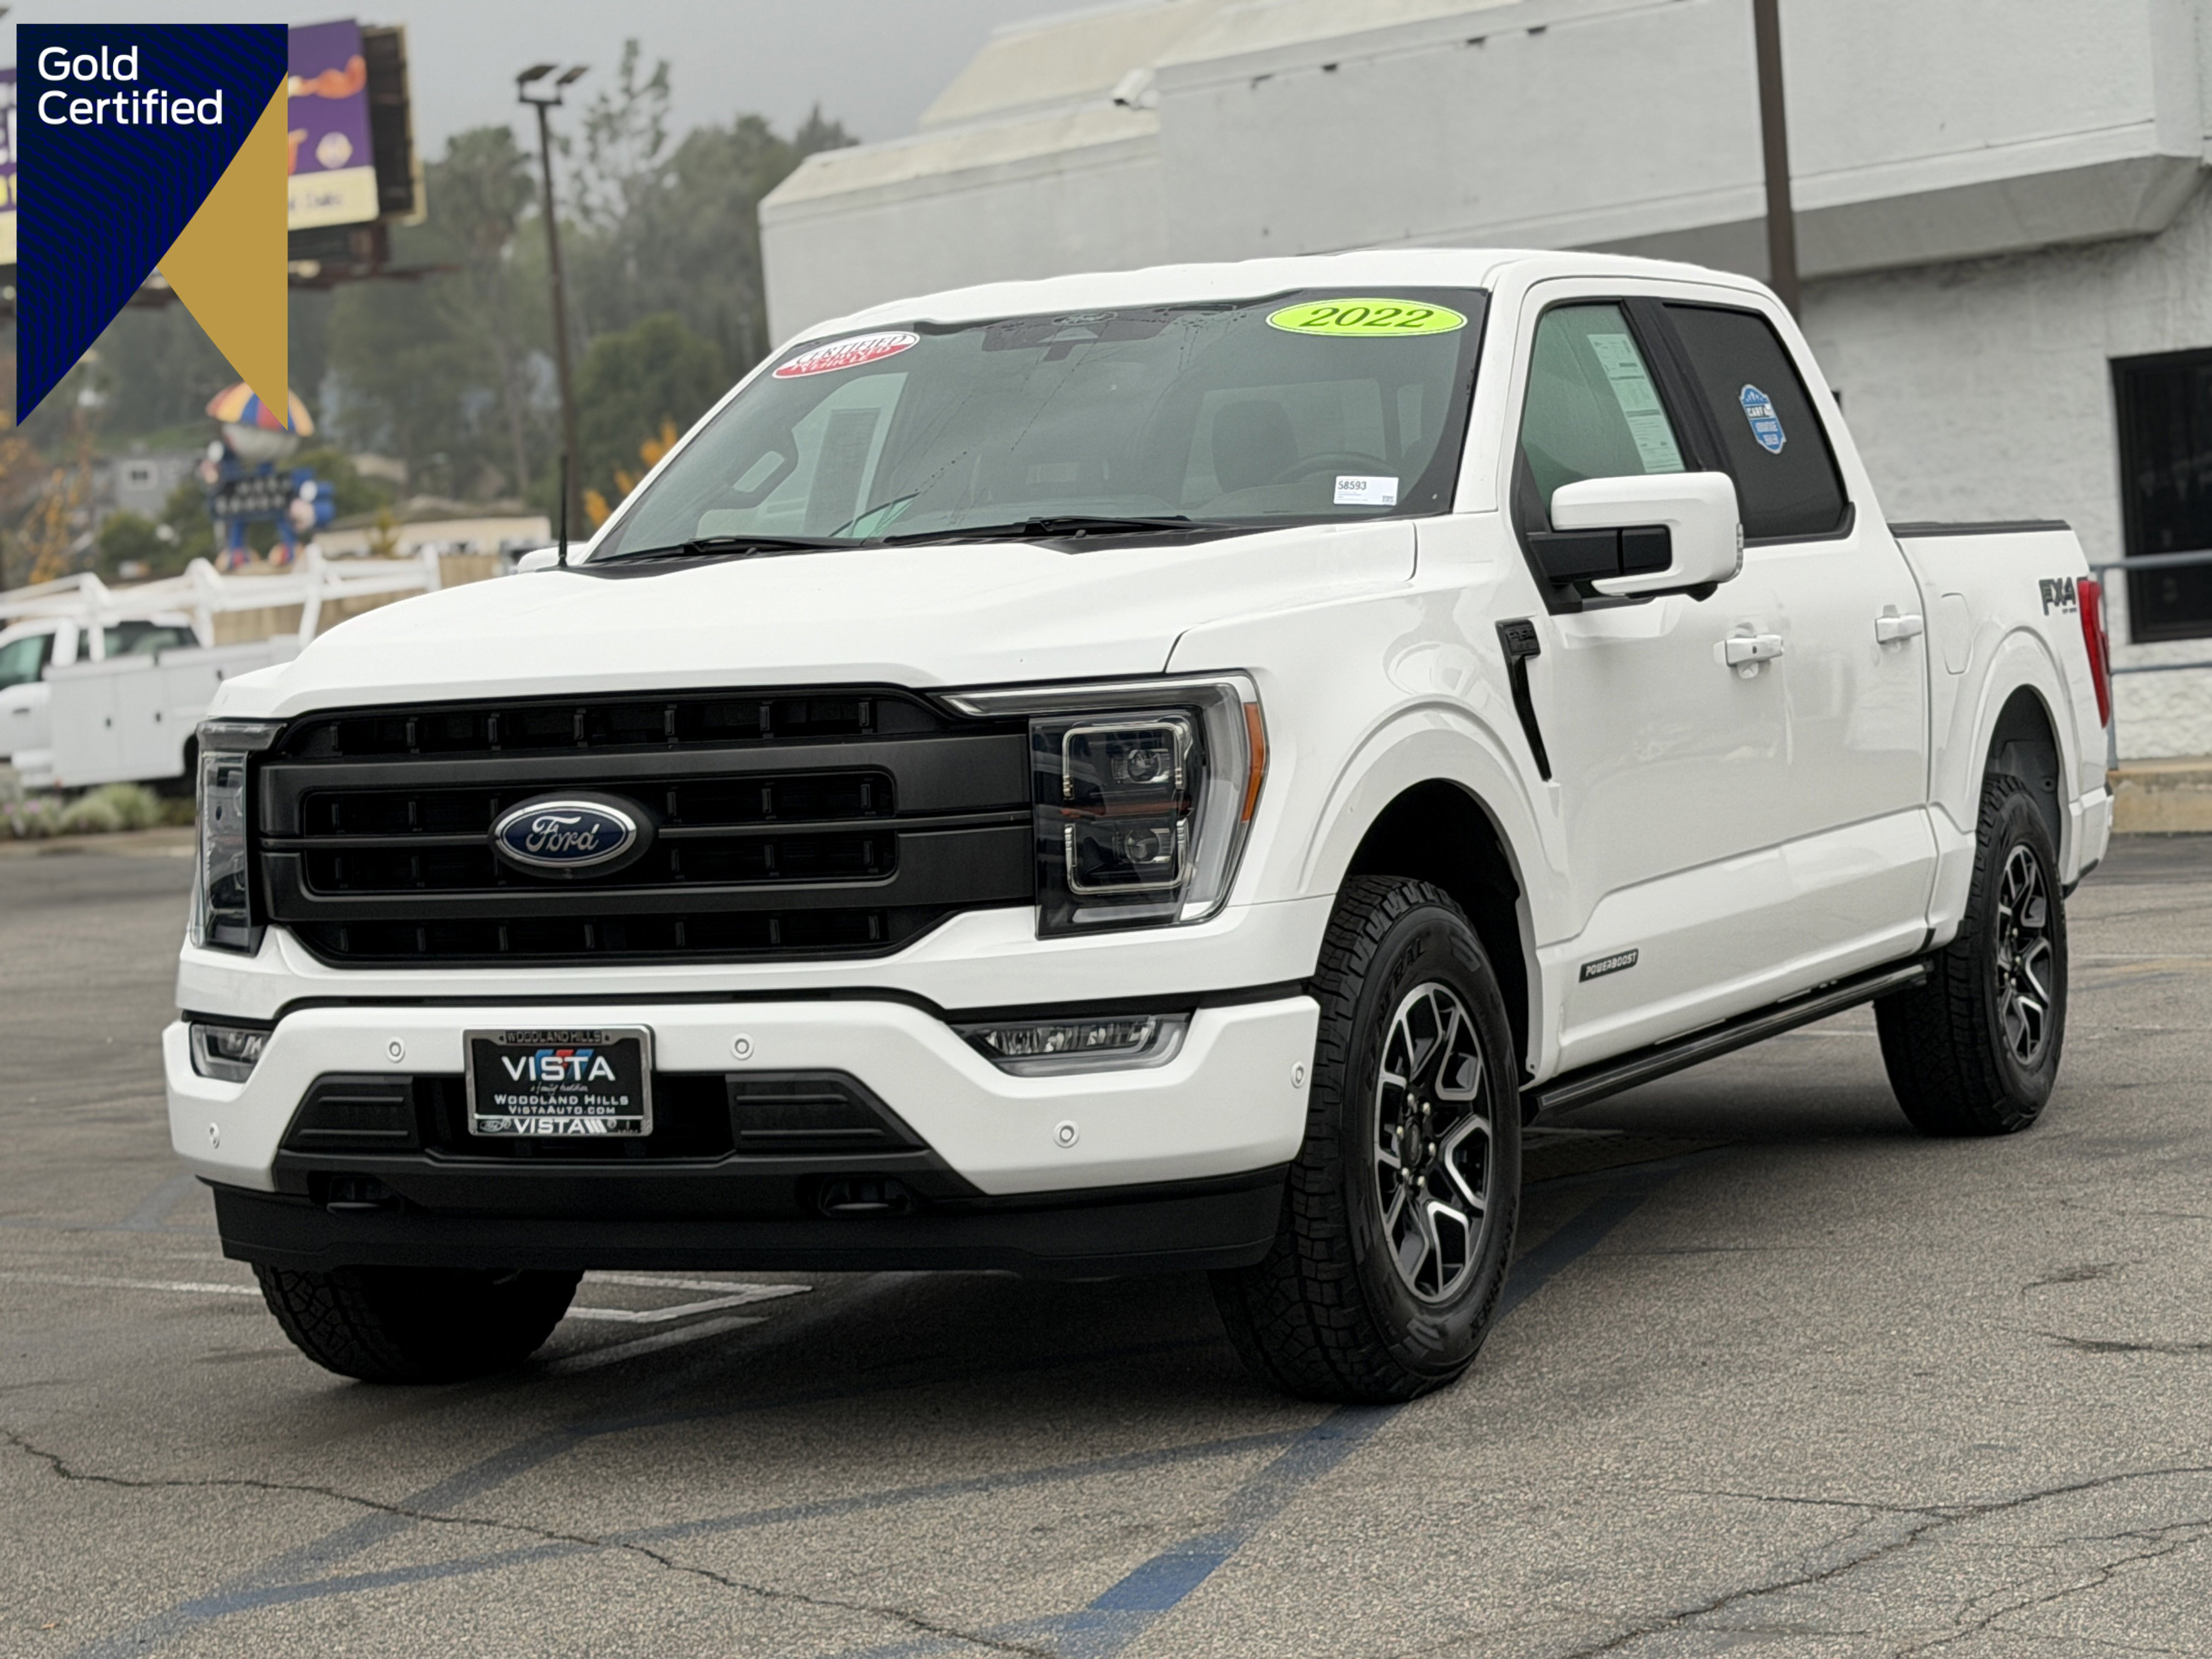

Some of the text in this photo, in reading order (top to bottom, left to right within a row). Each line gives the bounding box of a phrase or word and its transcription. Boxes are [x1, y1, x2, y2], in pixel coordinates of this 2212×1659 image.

[1298, 307, 1434, 328] 2022
[1338, 481, 1367, 490] 58593
[526, 815, 600, 852] Ford
[1585, 952, 1637, 977] POWERBOOST
[505, 1031, 601, 1042] WOODLAND HILLS
[501, 1056, 616, 1081] VISTA
[494, 1094, 629, 1105] WOODLAND HILLS
[514, 1118, 585, 1134] VISTA
